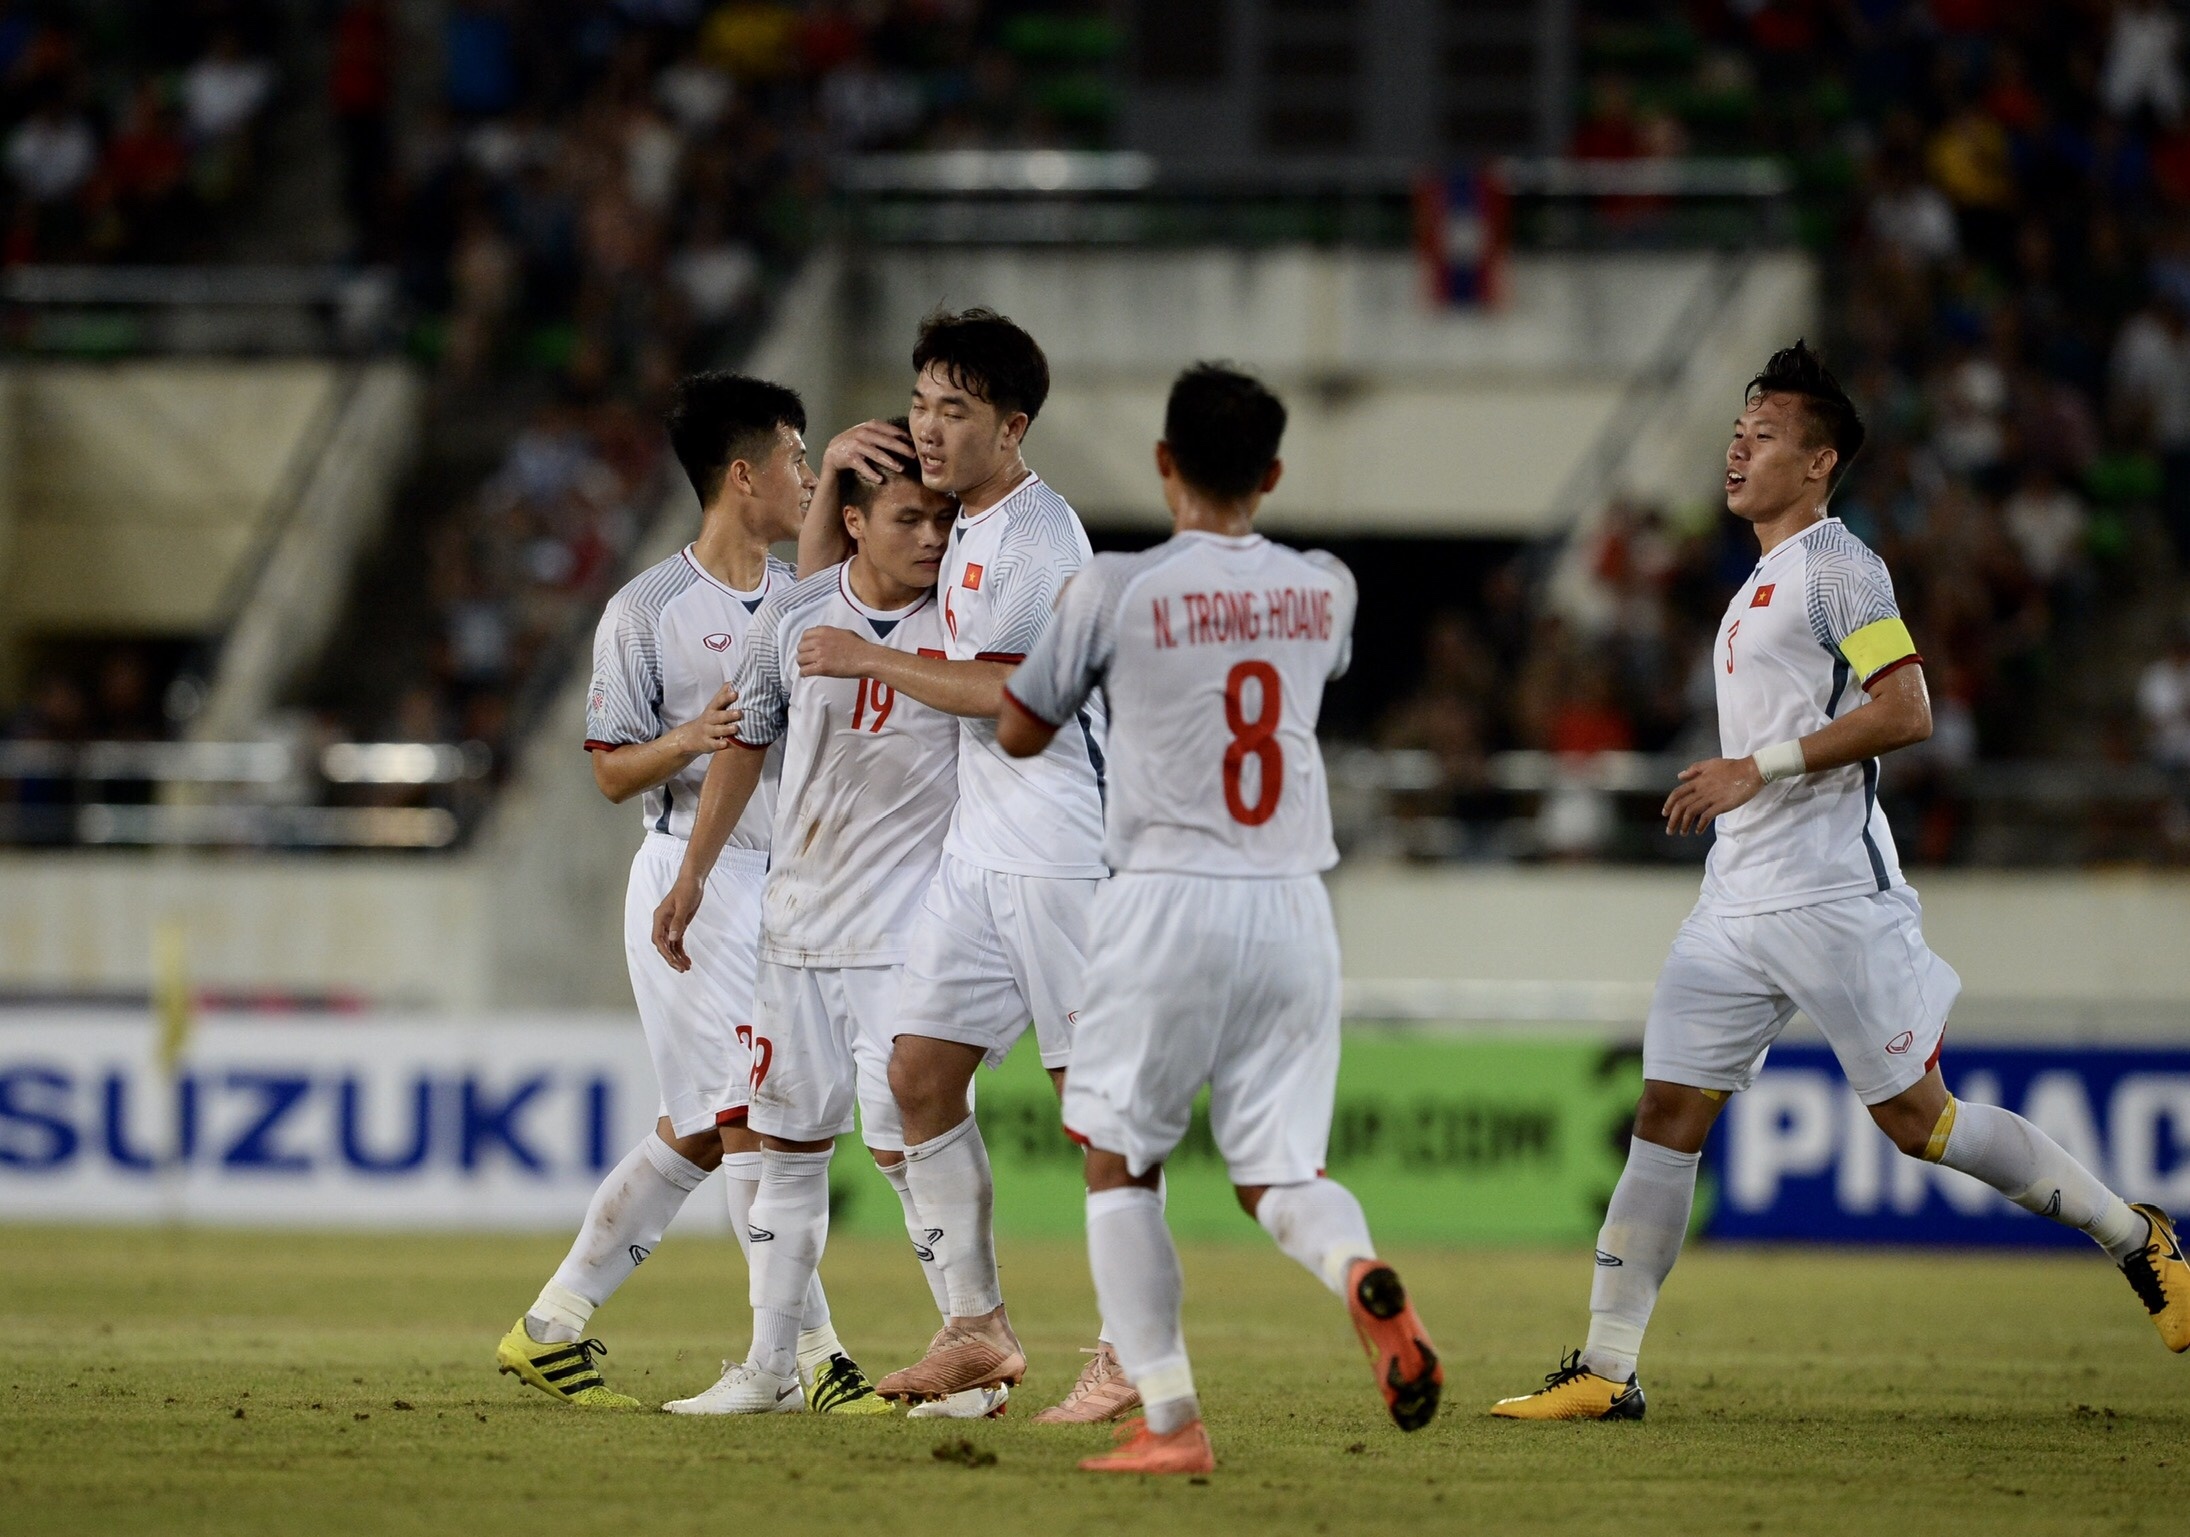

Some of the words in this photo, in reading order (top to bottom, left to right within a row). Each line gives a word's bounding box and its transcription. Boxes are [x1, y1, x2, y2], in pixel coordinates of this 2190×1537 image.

[1182, 590, 1261, 643] TRONG
[1265, 587, 1333, 641] HOANG
[851, 677, 895, 733] 19
[1222, 659, 1283, 827] 8
[0, 1065, 616, 1175] SUZUKI
